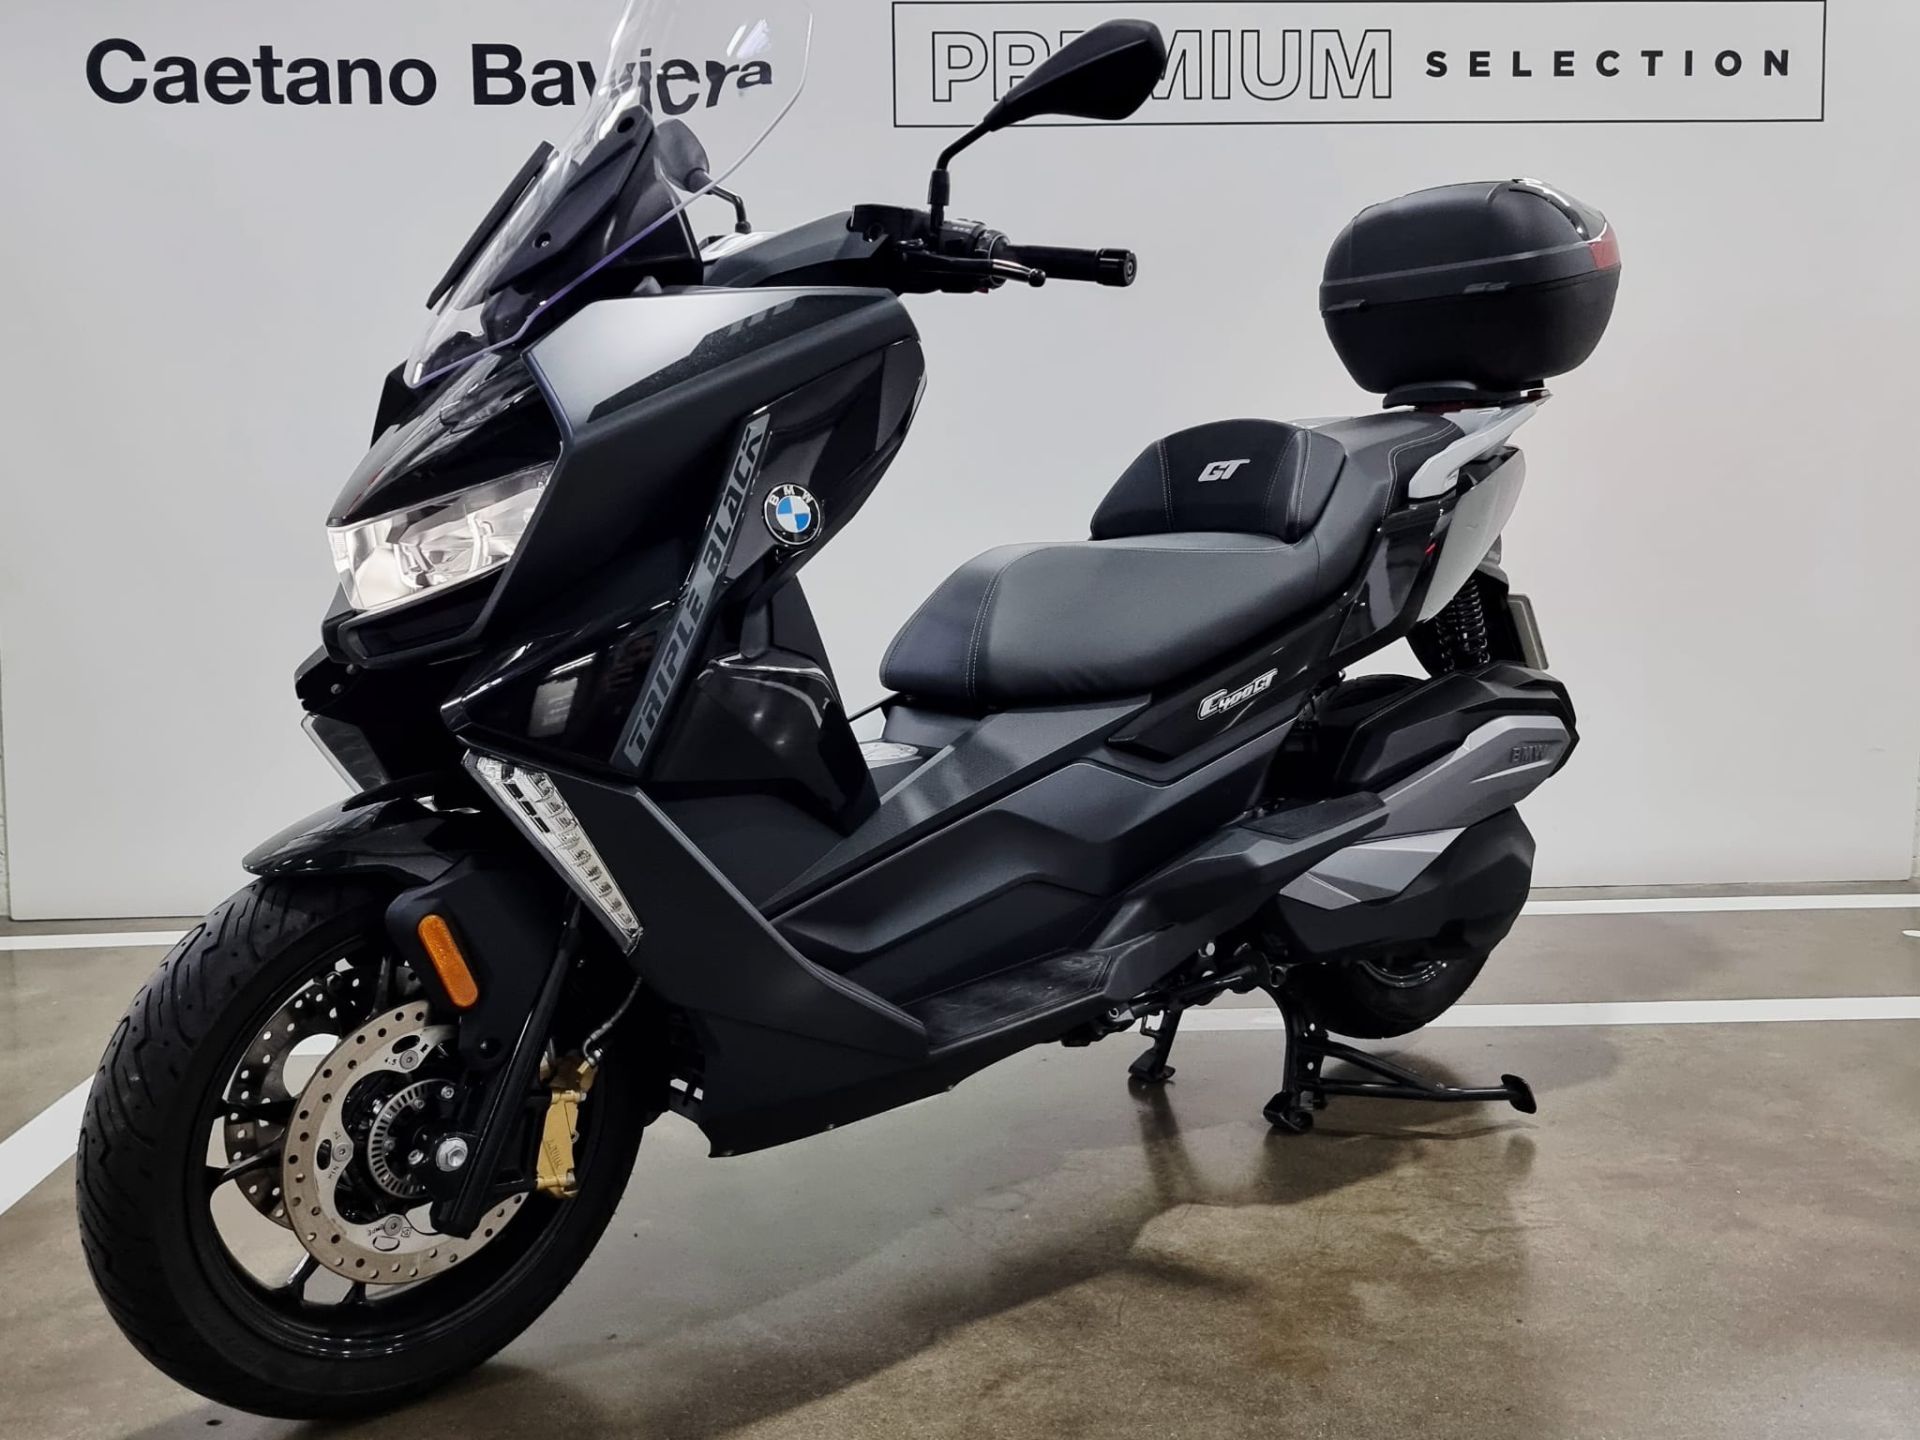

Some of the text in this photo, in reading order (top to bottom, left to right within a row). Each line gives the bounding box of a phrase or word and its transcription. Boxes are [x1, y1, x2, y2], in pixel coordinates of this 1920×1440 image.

[86, 38, 437, 106] Caetano
[932, 29, 1789, 102] PRMIUM SELECTION
[769, 485, 814, 506] BMW
[1198, 458, 1251, 482] GT
[629, 426, 763, 754] TRIPLE BLACK
